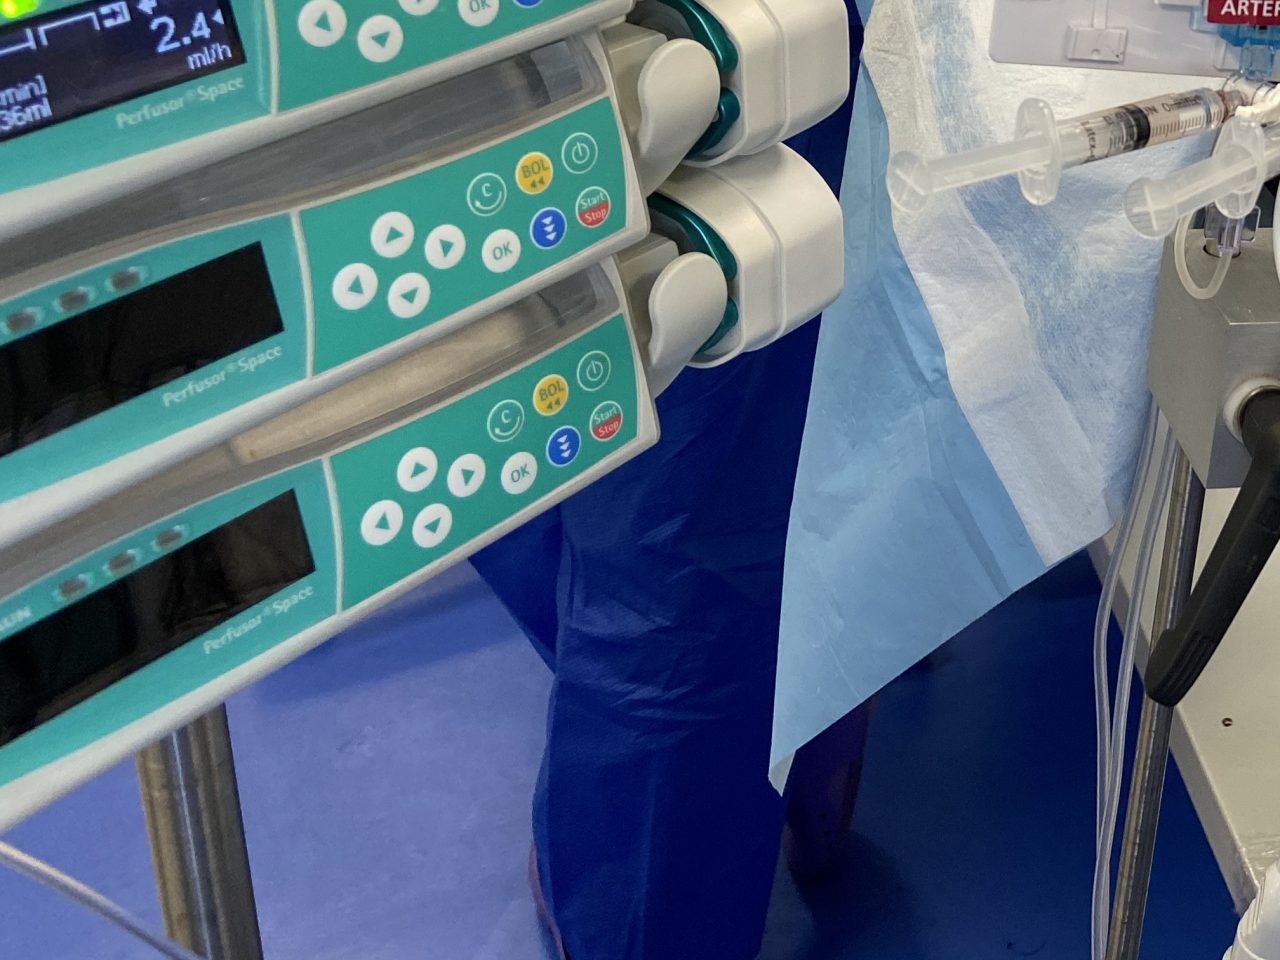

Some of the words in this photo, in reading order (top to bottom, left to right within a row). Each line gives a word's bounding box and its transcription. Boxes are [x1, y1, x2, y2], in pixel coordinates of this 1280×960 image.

[150, 11, 212, 53] 2.4
[186, 42, 233, 70] ml/h
[197, 77, 245, 102] Space
[521, 159, 550, 179] BOL
[481, 182, 493, 197] C
[580, 192, 606, 209] Start
[584, 207, 607, 223] Stop
[493, 241, 513, 261] OK
[237, 345, 283, 372] Space
[538, 380, 565, 401] BOL
[501, 409, 512, 423] C
[594, 406, 618, 424] Start
[598, 421, 619, 437] Stop
[510, 463, 530, 483] OK
[272, 585, 314, 615] Space
